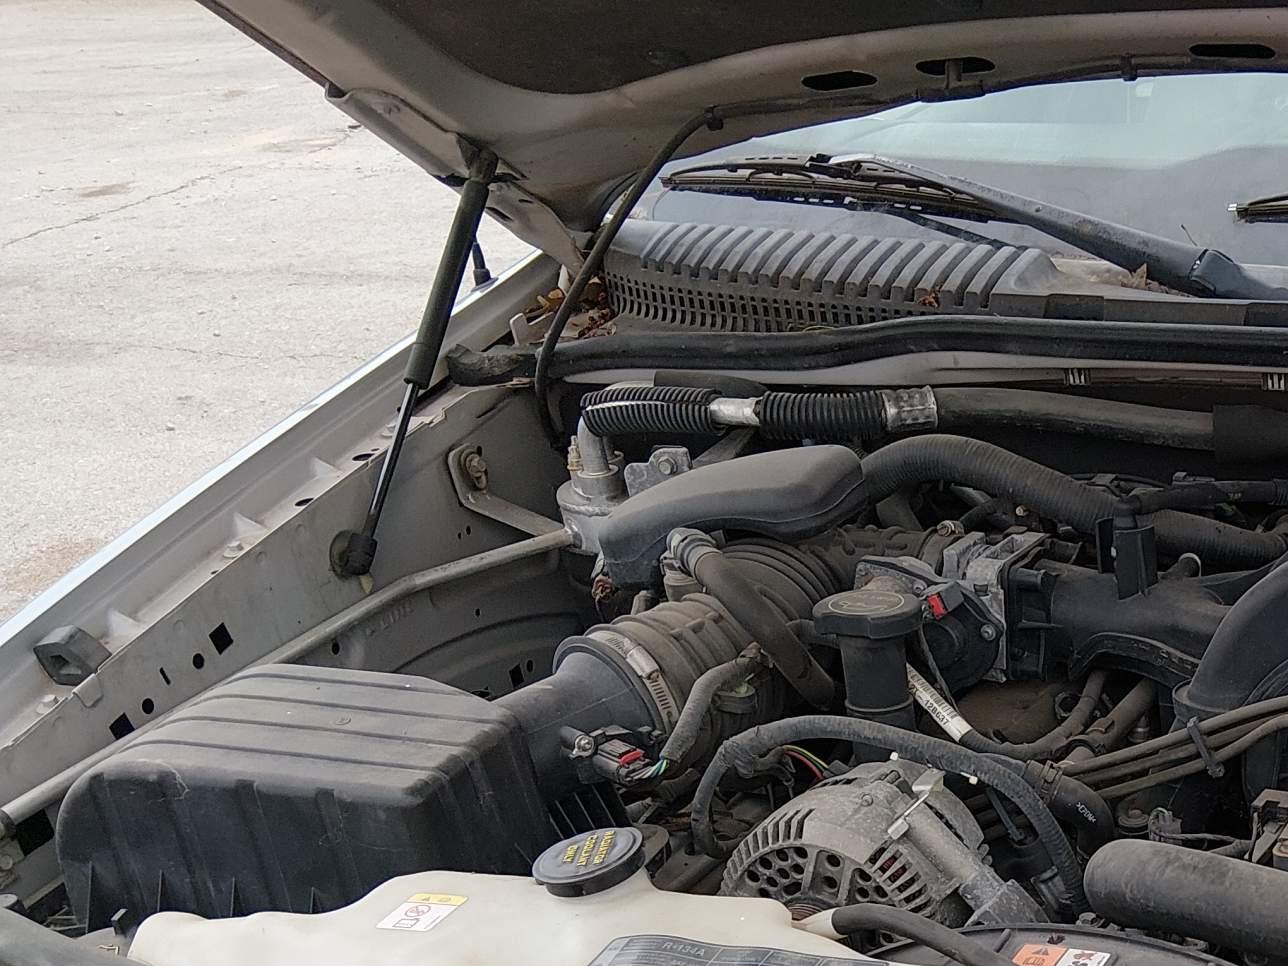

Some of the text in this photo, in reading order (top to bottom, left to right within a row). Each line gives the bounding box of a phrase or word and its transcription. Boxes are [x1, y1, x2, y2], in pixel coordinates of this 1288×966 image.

[563, 844, 579, 863] ONLY
[576, 833, 599, 866] COOLANT
[593, 830, 616, 865] RADIATOR
